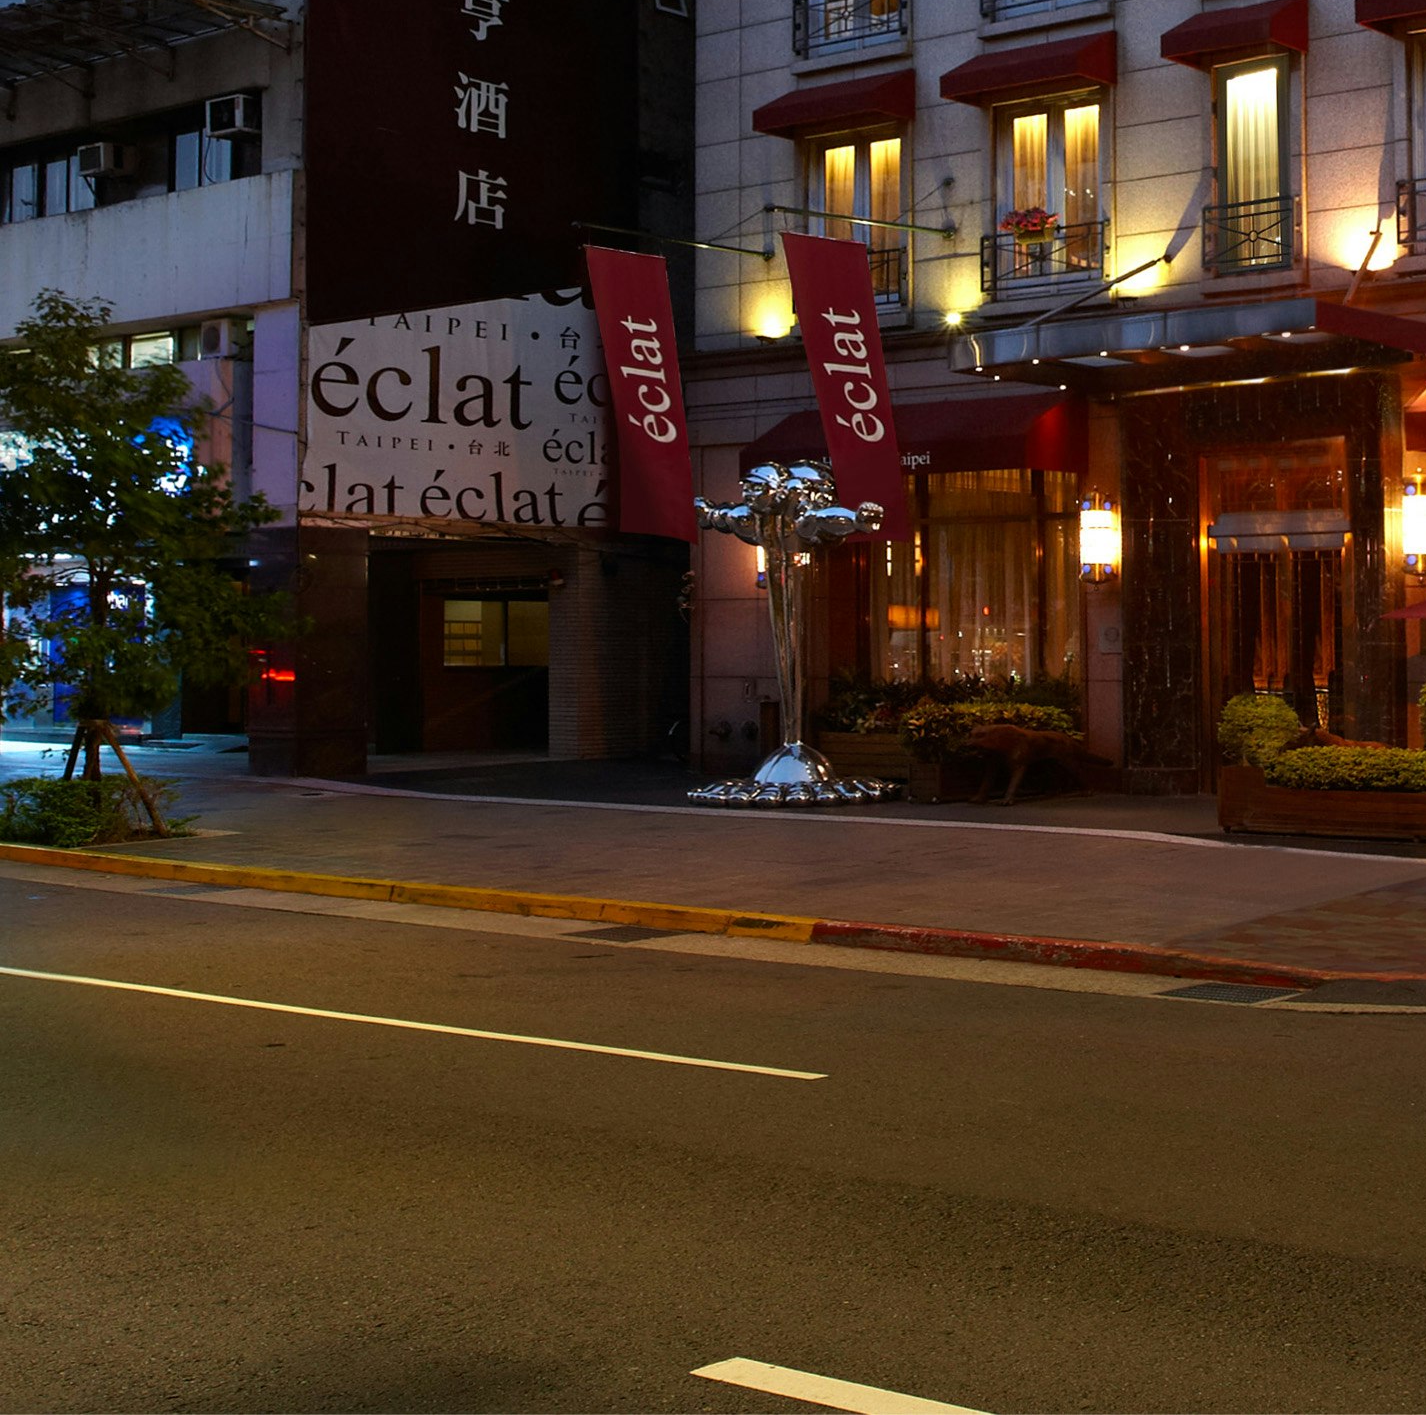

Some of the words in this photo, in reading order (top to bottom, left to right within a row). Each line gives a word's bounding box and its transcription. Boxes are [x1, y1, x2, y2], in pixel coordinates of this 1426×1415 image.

[311, 337, 533, 431] éclat
[621, 315, 677, 443] éclat
[821, 307, 885, 443] éclat
[336, 431, 434, 451] TAIPEI
[468, 440, 511, 457] 台北
[897, 450, 931, 470] aipei
[420, 469, 566, 527] éclat
